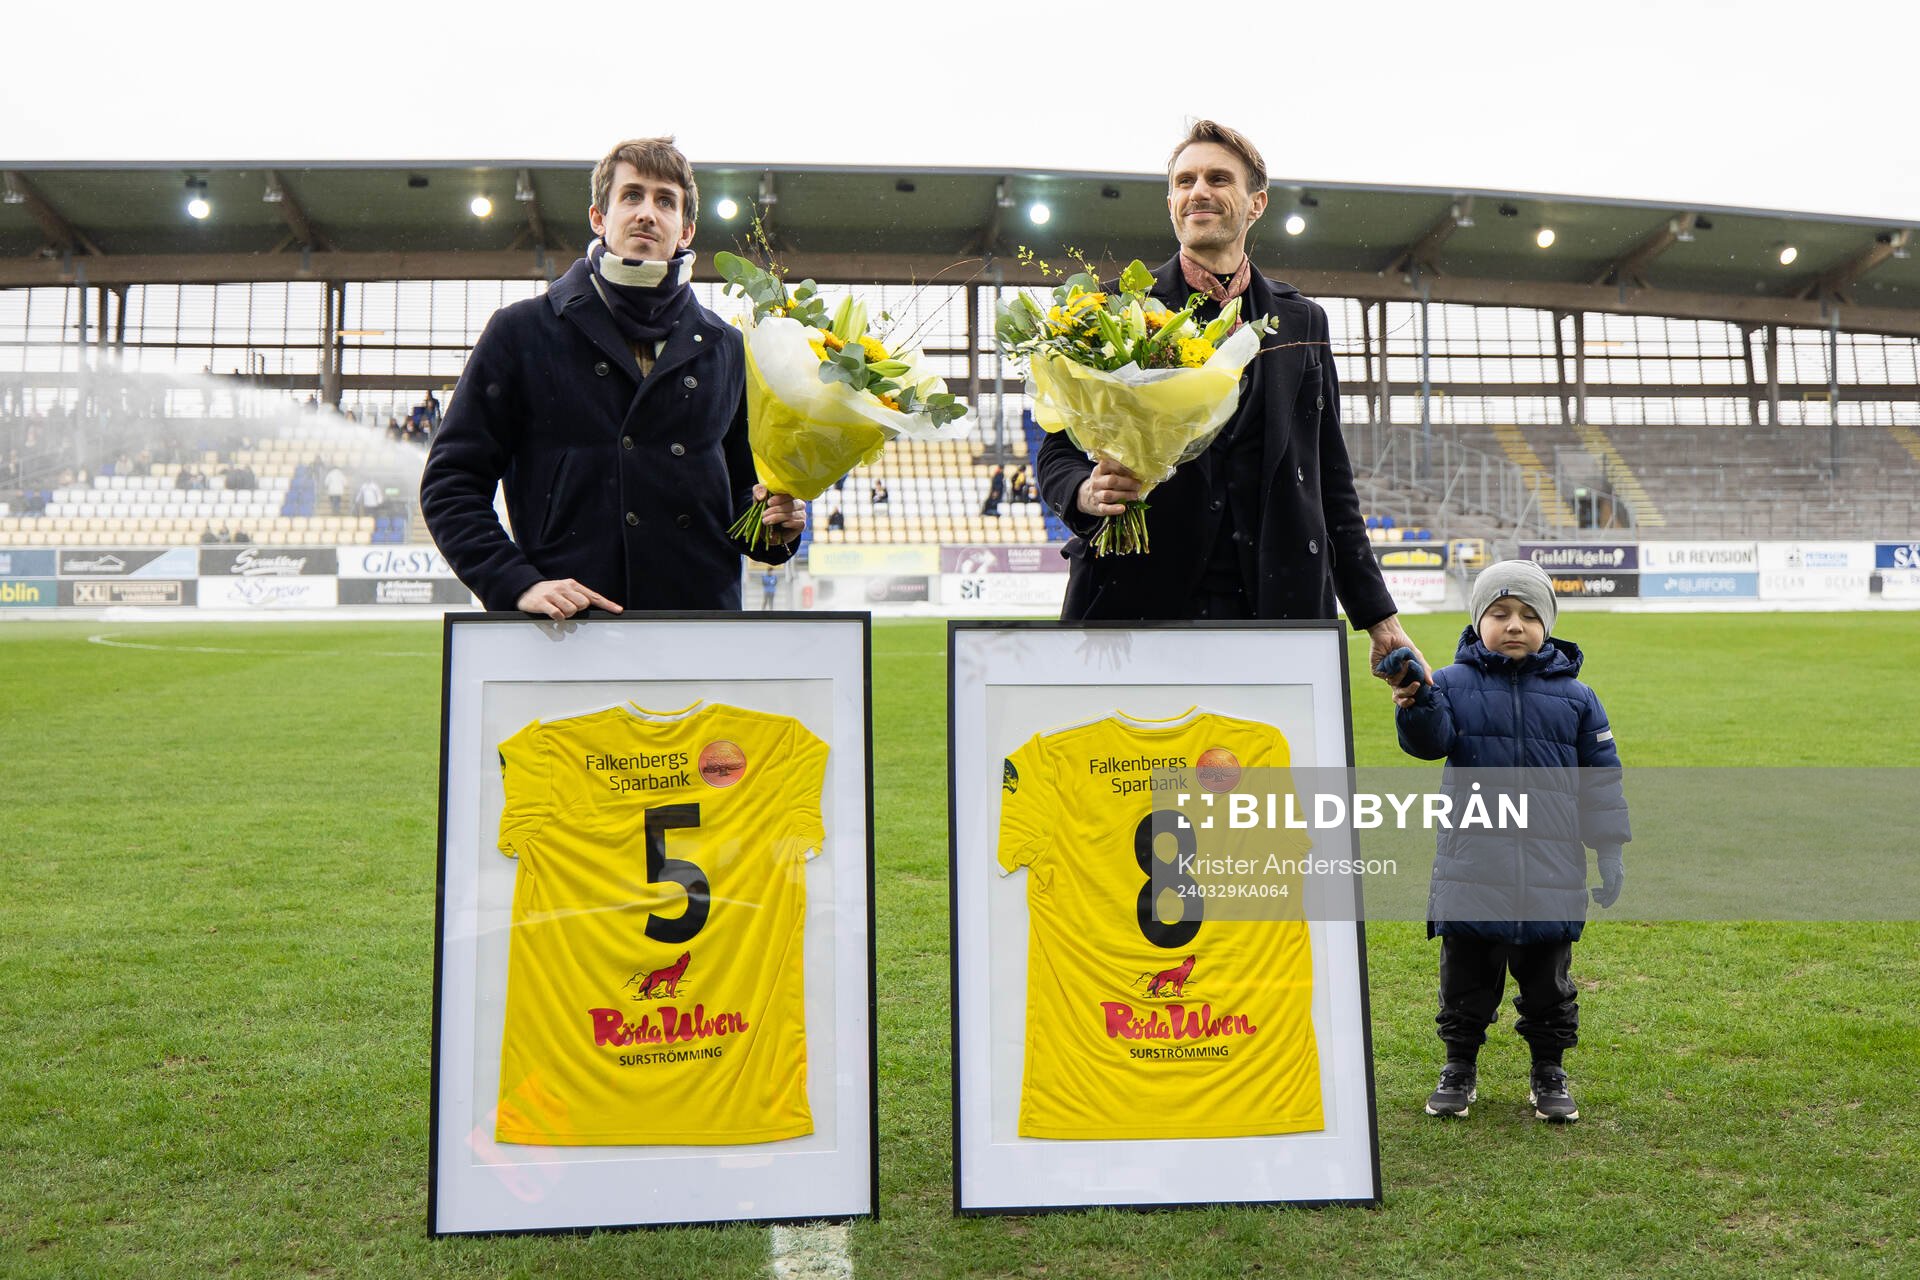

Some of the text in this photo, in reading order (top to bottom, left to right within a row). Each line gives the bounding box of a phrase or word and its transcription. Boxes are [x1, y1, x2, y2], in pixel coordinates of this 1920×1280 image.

[1668, 550, 1752, 564] LR REVISION
[0, 581, 40, 602] blin
[586, 750, 689, 771] Falkenbergs
[1089, 755, 1187, 775] Falkenbergs
[609, 770, 691, 794] Sparbank
[1111, 774, 1188, 796] Sparbank
[644, 803, 711, 944] 5
[1134, 809, 1205, 949] 8
[587, 1006, 663, 1047] Röda
[1100, 1001, 1169, 1040] Röda
[619, 1047, 723, 1067] SURSTRÖMMING
[1129, 1044, 1229, 1060] SURSTRÖMMING
